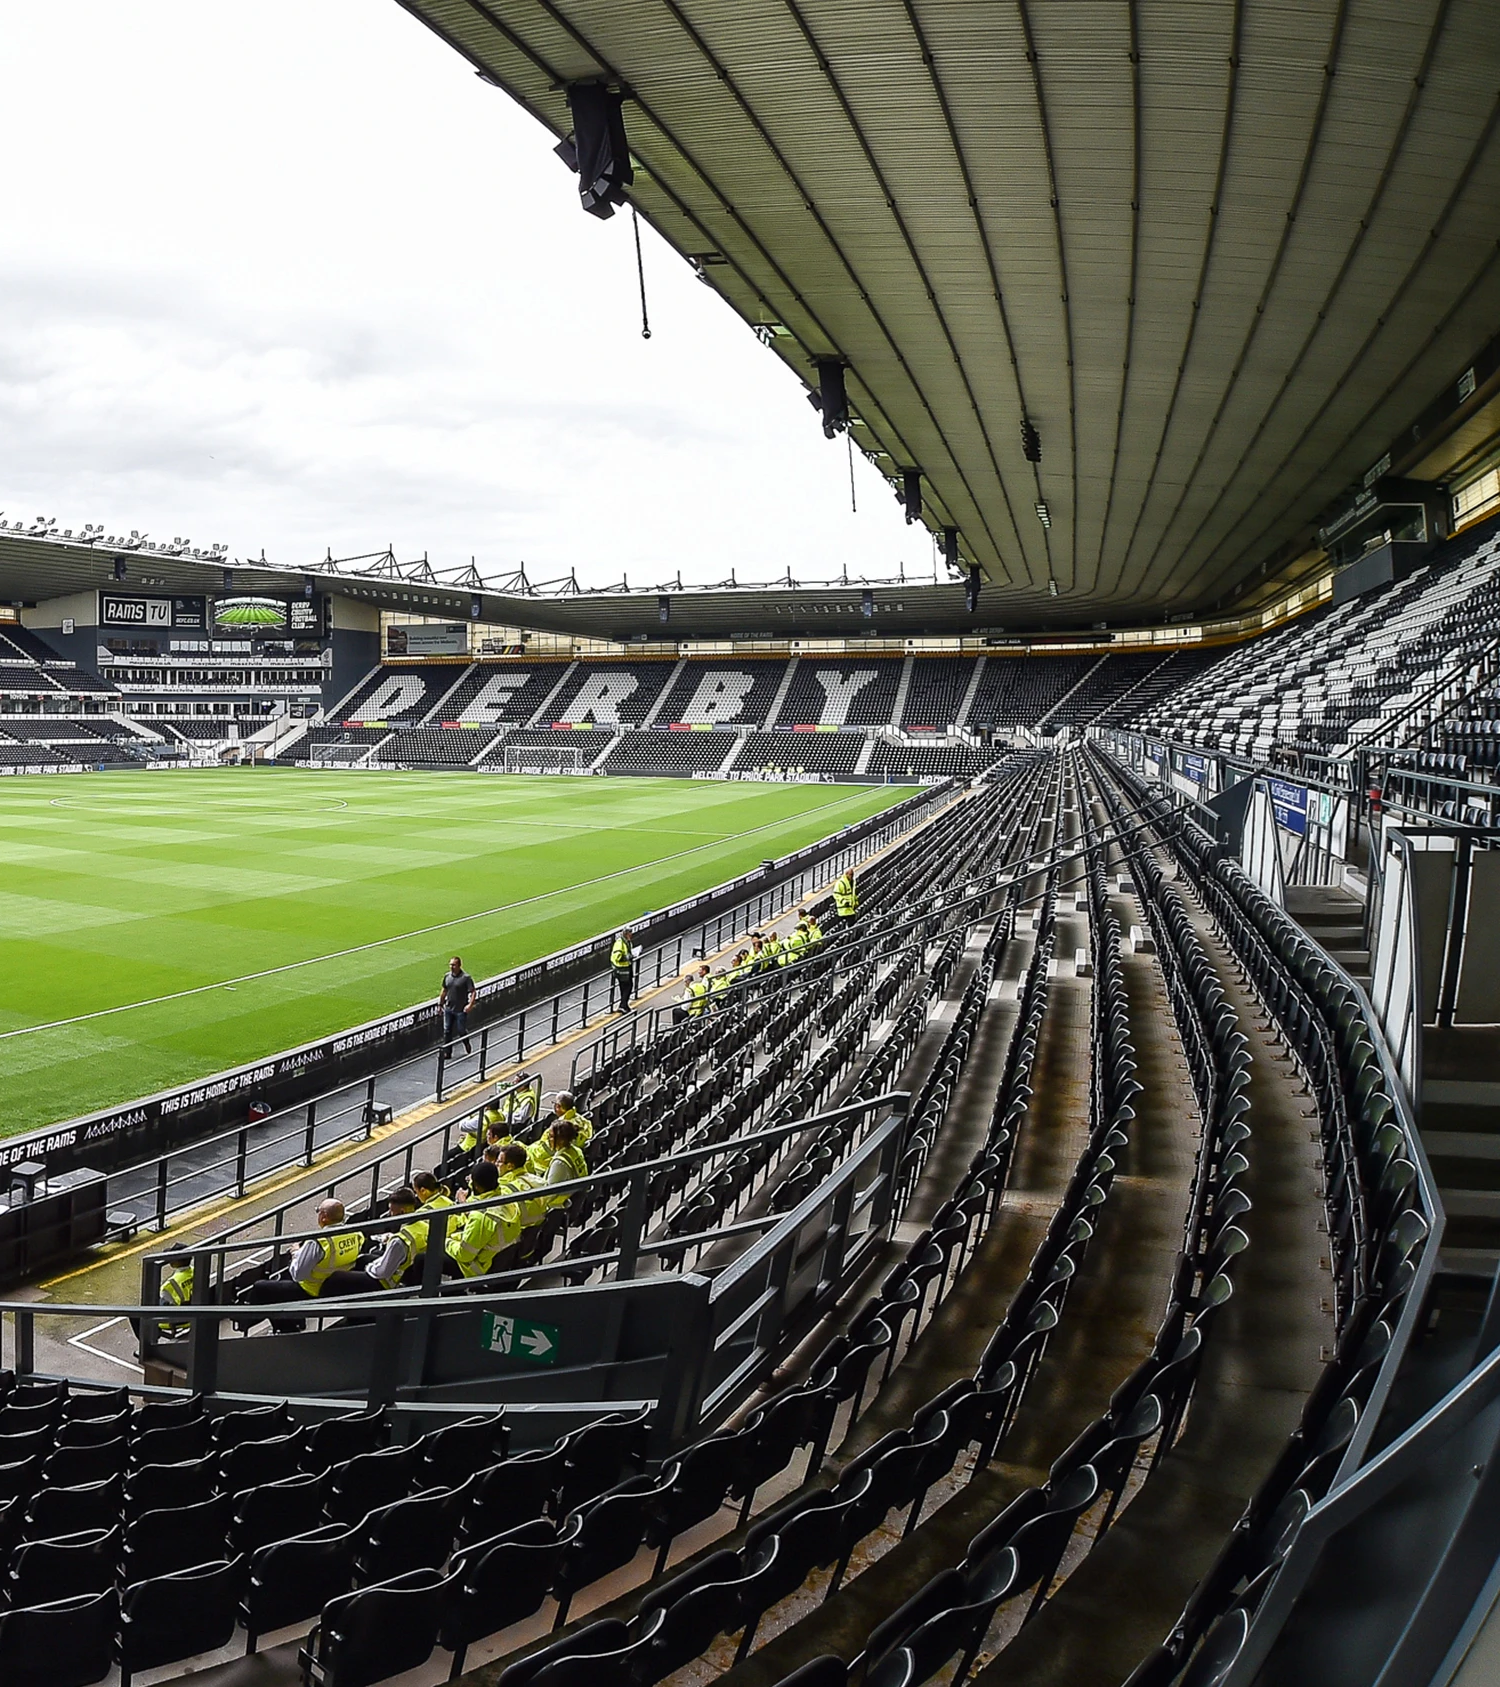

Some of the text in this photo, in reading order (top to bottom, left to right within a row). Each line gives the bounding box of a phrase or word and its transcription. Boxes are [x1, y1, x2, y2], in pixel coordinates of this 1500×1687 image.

[107, 602, 145, 619] RAMS
[150, 604, 167, 620] TV
[291, 601, 311, 609] DERBY
[290, 608, 313, 616] COUNTY
[291, 614, 318, 622] FOOTBALL
[348, 670, 878, 725] DERBY
[16, 765, 24, 775] TO
[25, 765, 42, 775] PRIDE
[42, 764, 58, 774] PARK
[58, 763, 83, 774] STADIUM
[146, 760, 168, 770] WELCOME
[169, 760, 176, 769] TO
[177, 760, 190, 769] PRIDE
[521, 766, 542, 775] PRIDE
[543, 766, 561, 775] PARK
[692, 770, 820, 783] WELCOME TO PRIDE PARK STADIUM
[919, 774, 952, 785] WELCOM
[333, 1014, 415, 1054] THIS IS THE HOME OF THE RAMS
[161, 1064, 275, 1116] THIS IS THE HOME OF THE RAMS
[10, 1147, 25, 1165] OF
[24, 1140, 47, 1160] THE
[47, 1130, 77, 1154] RAMS
[338, 1236, 357, 1250] CREW
